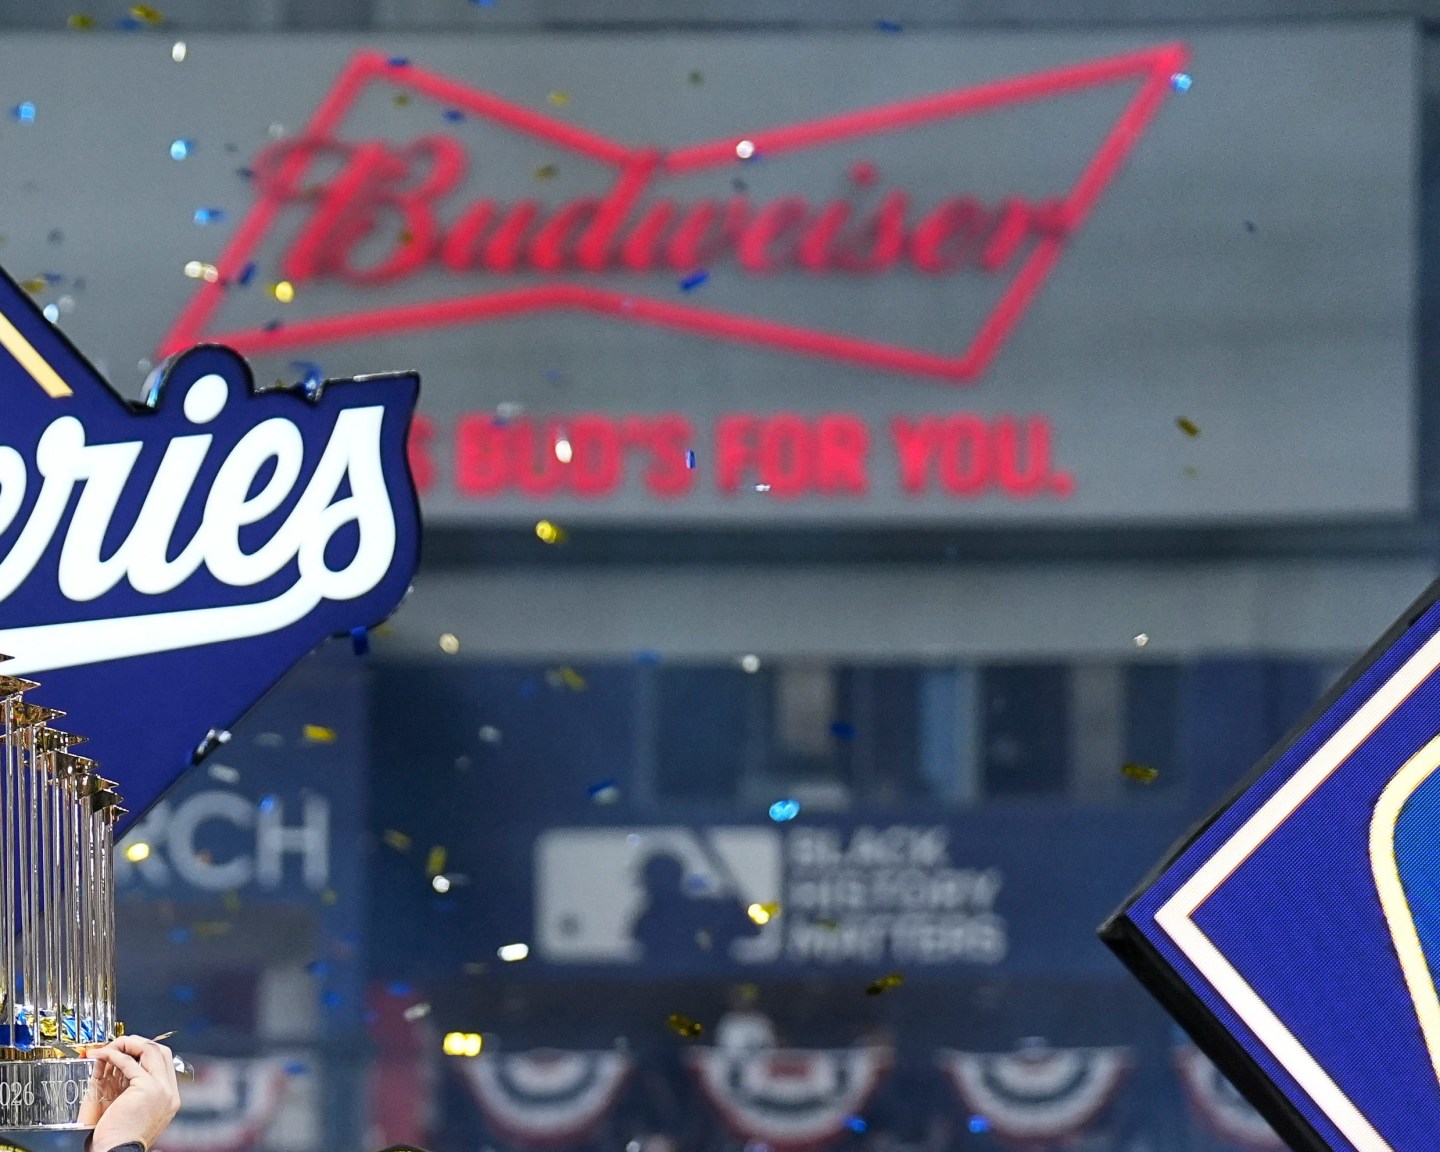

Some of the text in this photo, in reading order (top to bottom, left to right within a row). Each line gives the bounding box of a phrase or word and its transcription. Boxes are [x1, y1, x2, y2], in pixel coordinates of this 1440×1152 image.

[256, 135, 1076, 284] Budweiser
[457, 414, 694, 497] BUD'S
[717, 416, 868, 495] FOR
[788, 826, 948, 869] BLACK
[788, 868, 1003, 911] HISTORY
[786, 916, 1007, 964] MATTERS
